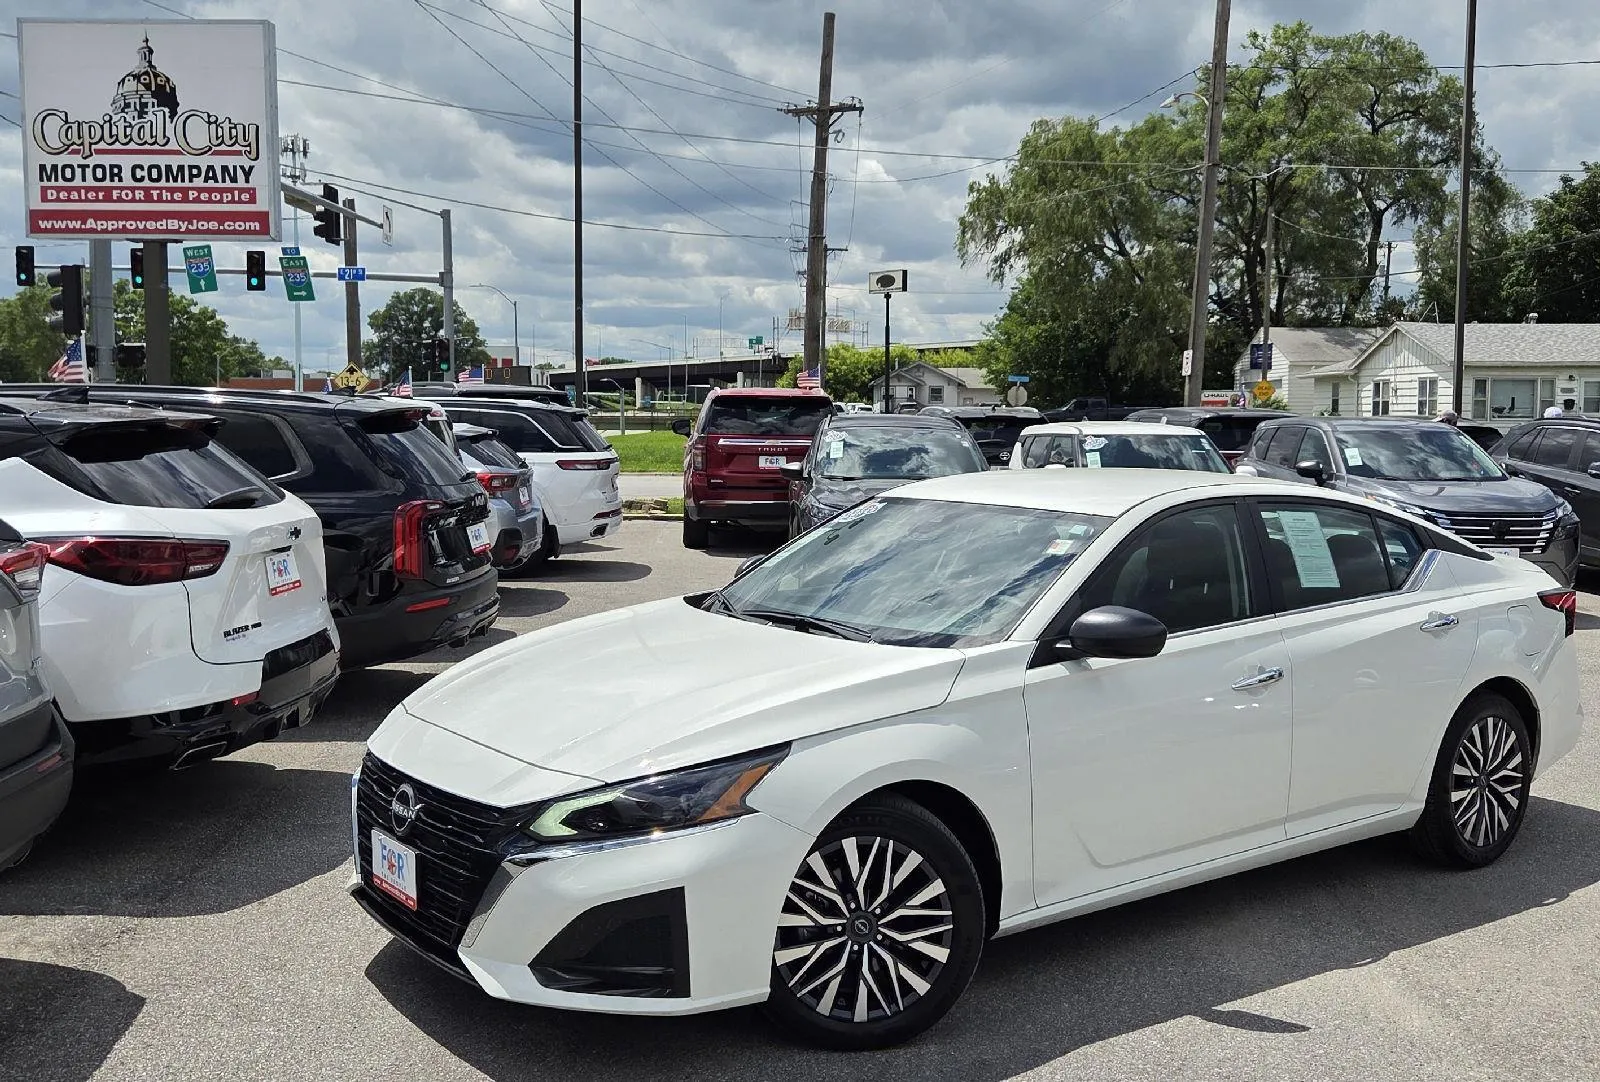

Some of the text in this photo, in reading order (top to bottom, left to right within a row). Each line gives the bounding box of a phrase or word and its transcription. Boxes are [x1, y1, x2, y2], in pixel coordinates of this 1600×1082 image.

[32, 108, 260, 161] Capital City
[38, 163, 255, 184] MOTOR COMPANY
[47, 189, 250, 202] Dealer FOR The People
[38, 217, 260, 231] www.ApprovedByJoe.com
[185, 248, 209, 257] WEST
[190, 261, 210, 273] 235
[282, 258, 304, 267] EAST
[287, 272, 307, 282] 235
[223, 624, 250, 638] BLAZER
